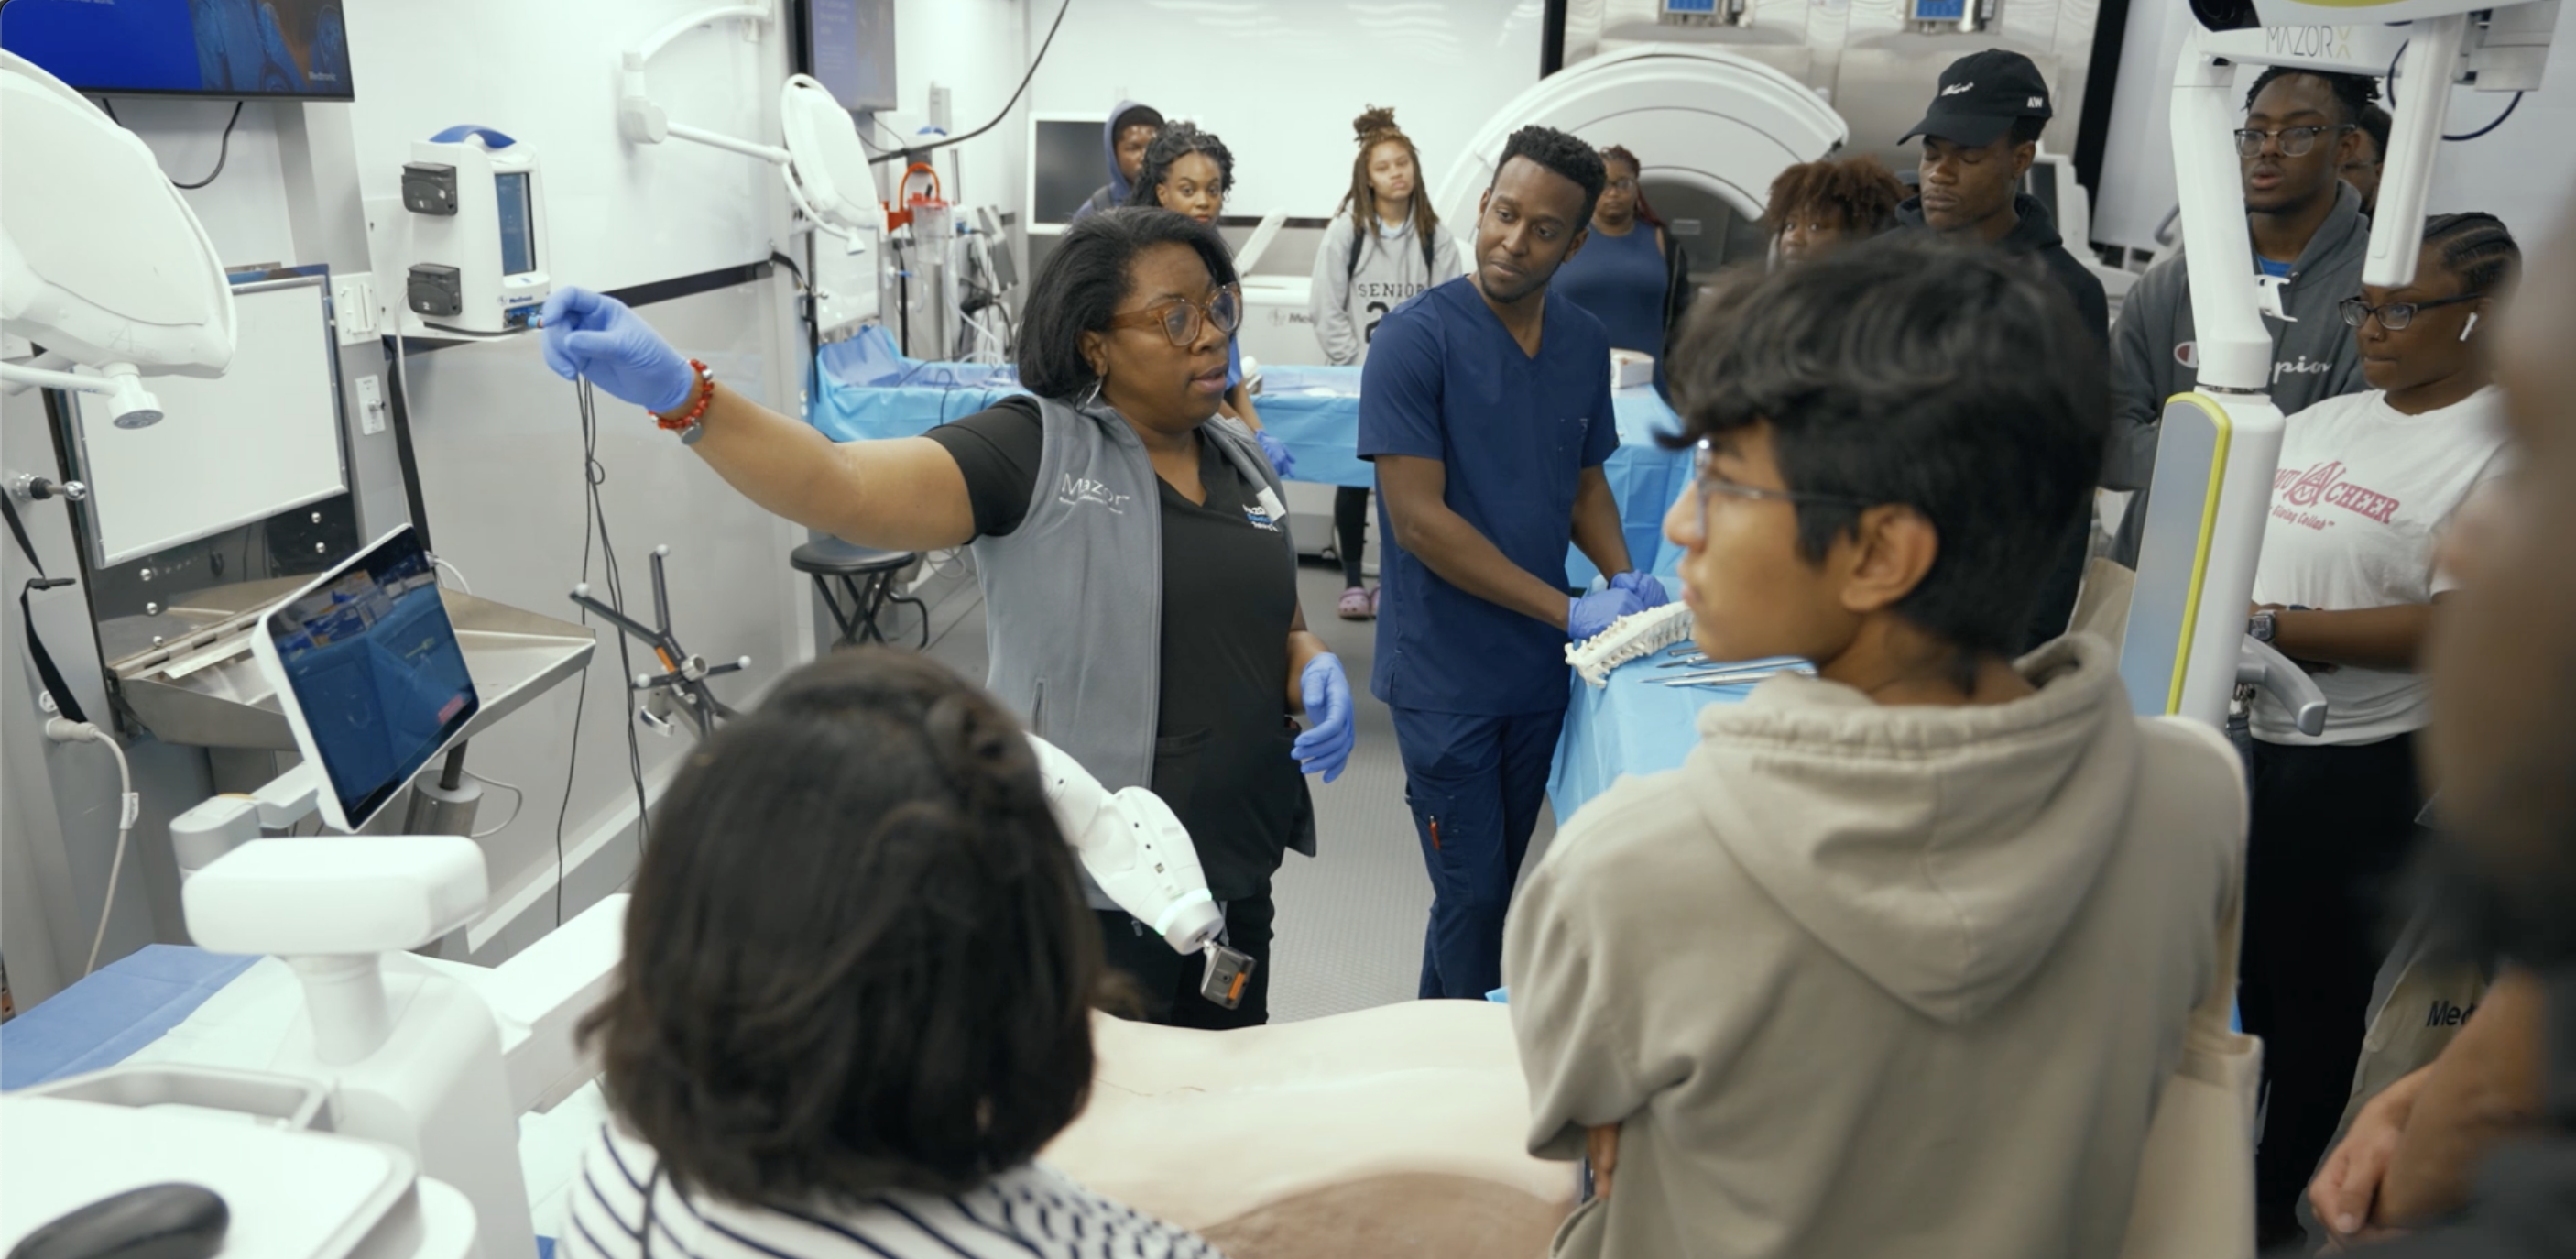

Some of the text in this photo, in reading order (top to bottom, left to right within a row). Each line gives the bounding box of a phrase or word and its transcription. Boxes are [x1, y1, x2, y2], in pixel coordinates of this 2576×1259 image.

[2266, 26, 2333, 58] MAZOR
[1062, 472, 1130, 506] Mazor
[2324, 482, 2400, 525] CHEER
